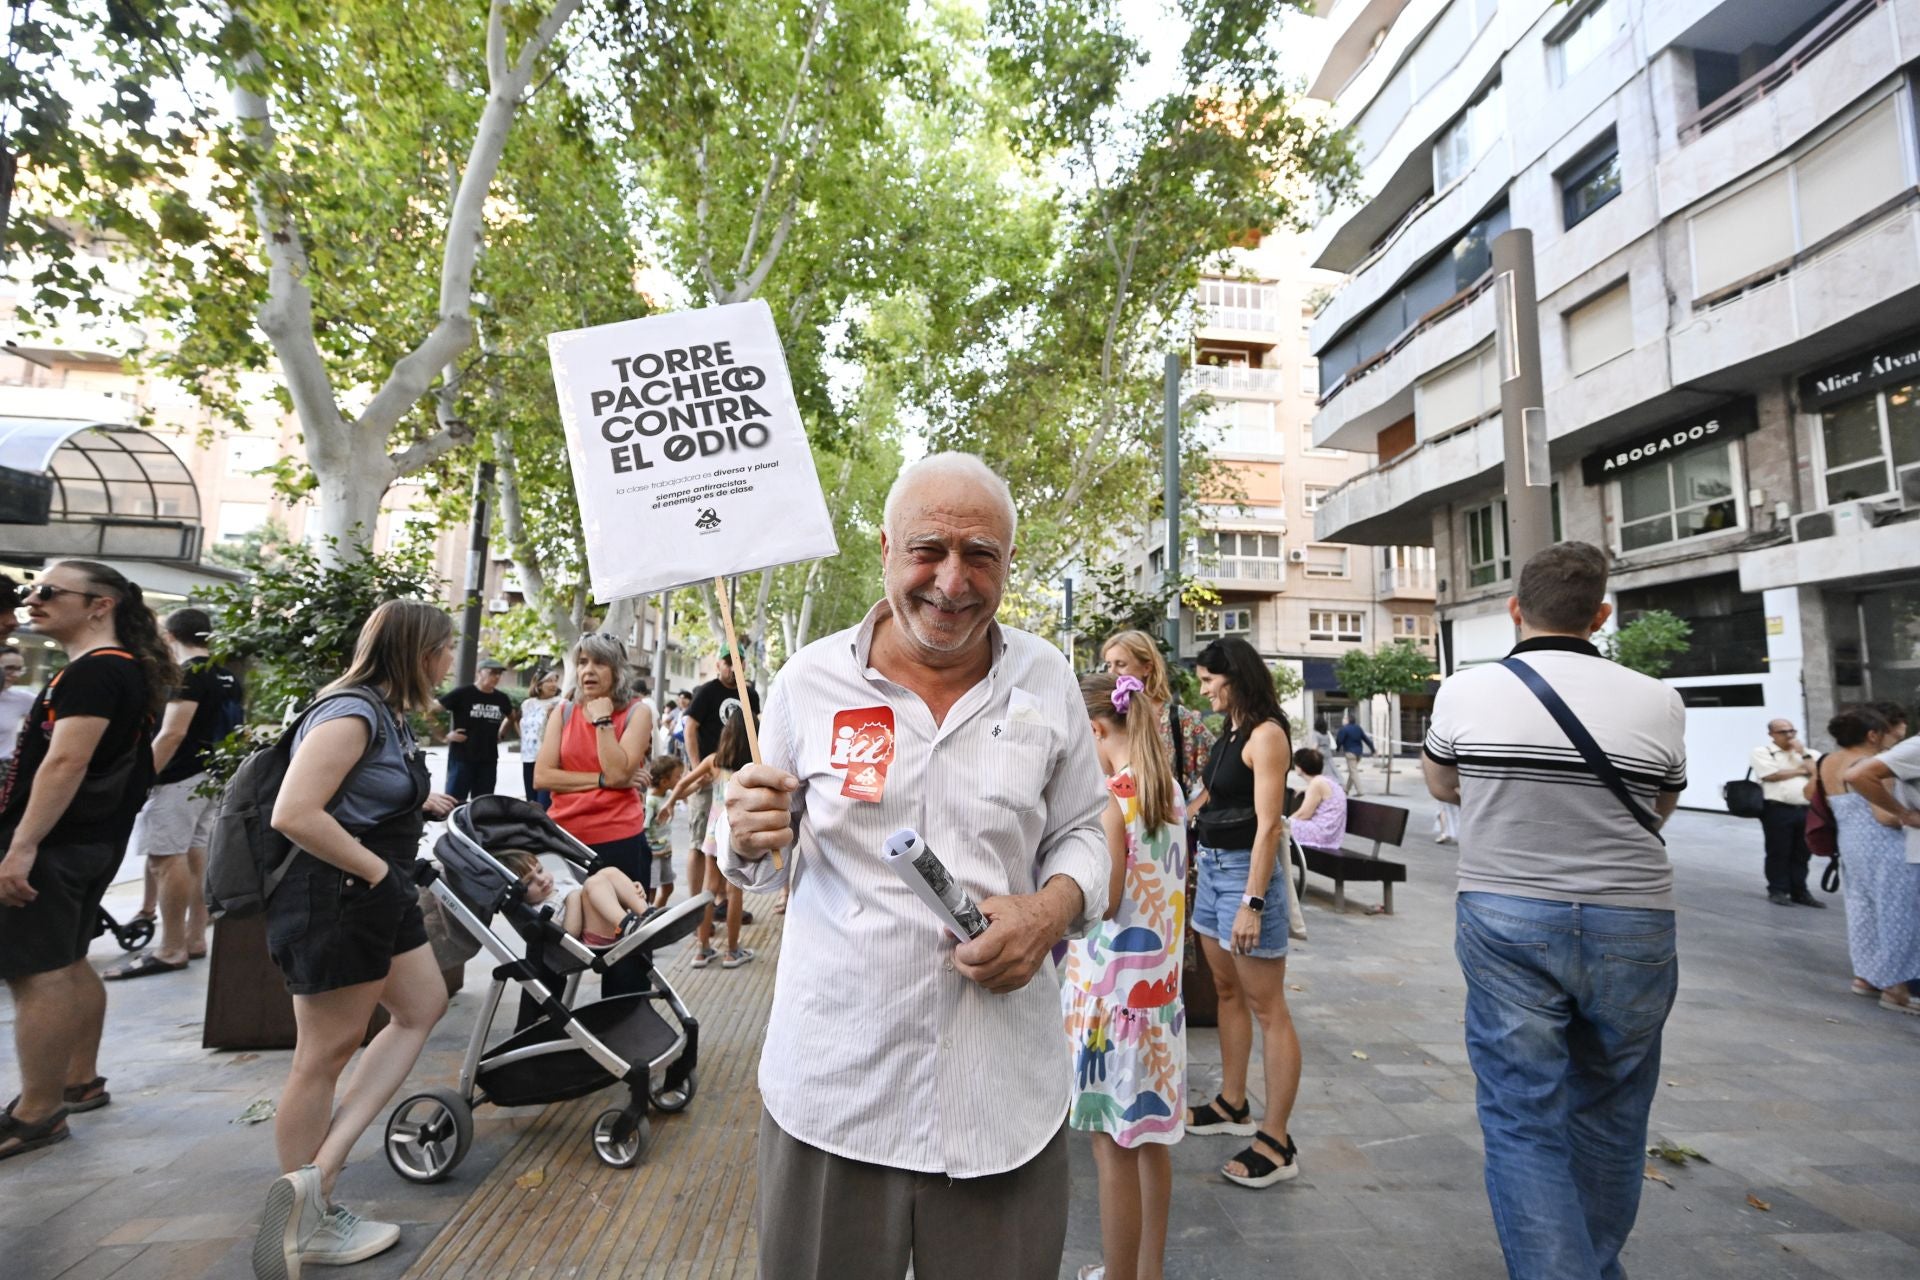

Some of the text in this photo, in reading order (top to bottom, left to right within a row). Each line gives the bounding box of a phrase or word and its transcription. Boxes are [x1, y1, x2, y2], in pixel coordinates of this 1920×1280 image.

[611, 340, 735, 384] TORRE
[1816, 350, 1920, 396] Mier Álva
[590, 365, 766, 417] PACHECO
[601, 395, 773, 443] CONTRA
[610, 442, 654, 474] EL
[1603, 419, 1720, 471] ABOGADOS
[626, 483, 650, 494] clase
[651, 472, 701, 490] trabajadora
[713, 466, 746, 477] diversa
[754, 460, 779, 471] plural
[655, 478, 748, 502] siempre antirracistas
[652, 484, 754, 510] el enemigo es de clase
[699, 519, 720, 530] PCE
